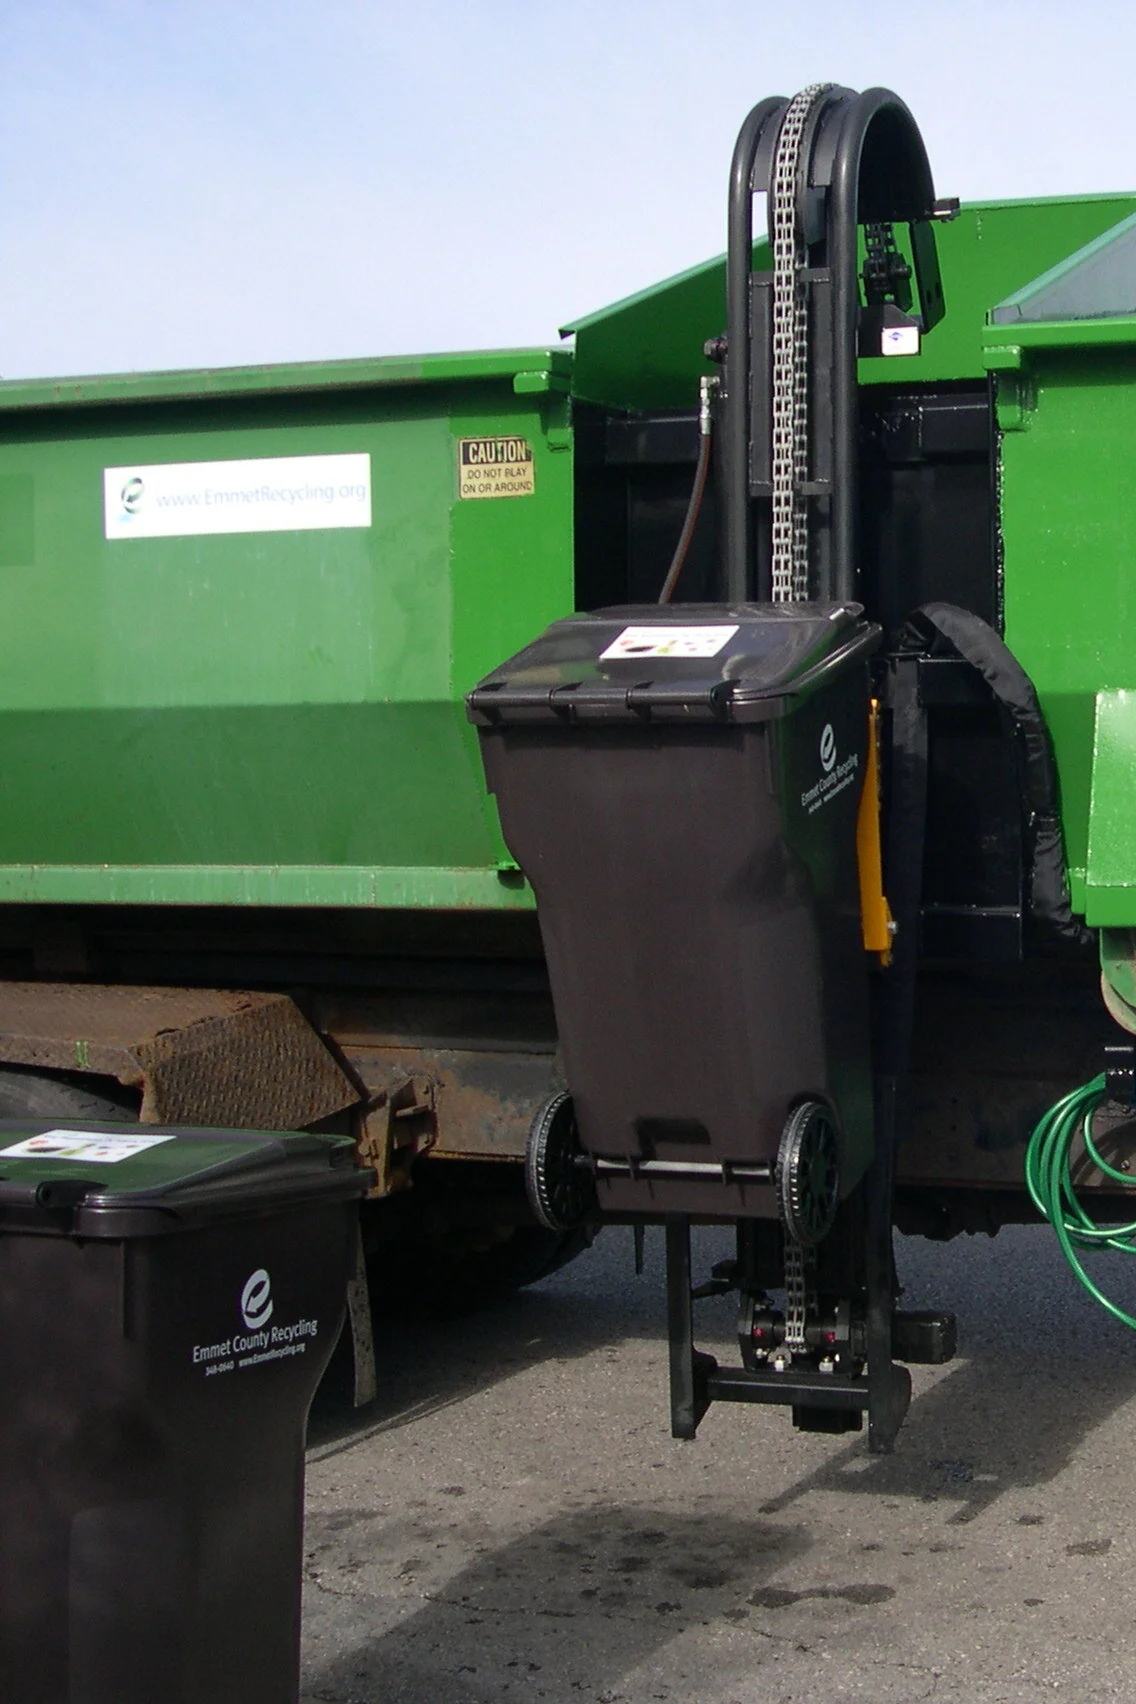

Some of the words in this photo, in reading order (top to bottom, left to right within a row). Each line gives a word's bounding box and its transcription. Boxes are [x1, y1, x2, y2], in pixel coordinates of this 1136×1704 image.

[469, 441, 526, 463] CAUTION
[468, 470, 481, 479] DO
[483, 469, 501, 478] NOT
[504, 467, 527, 477] PLAY
[157, 484, 366, 508] www.EmmetRecycling.org
[463, 484, 476, 493] ON
[478, 482, 492, 492] OR
[495, 481, 532, 492] AROUND
[193, 1340, 231, 1362] Emmet
[233, 1331, 269, 1353] County
[271, 1320, 317, 1342] Recycling
